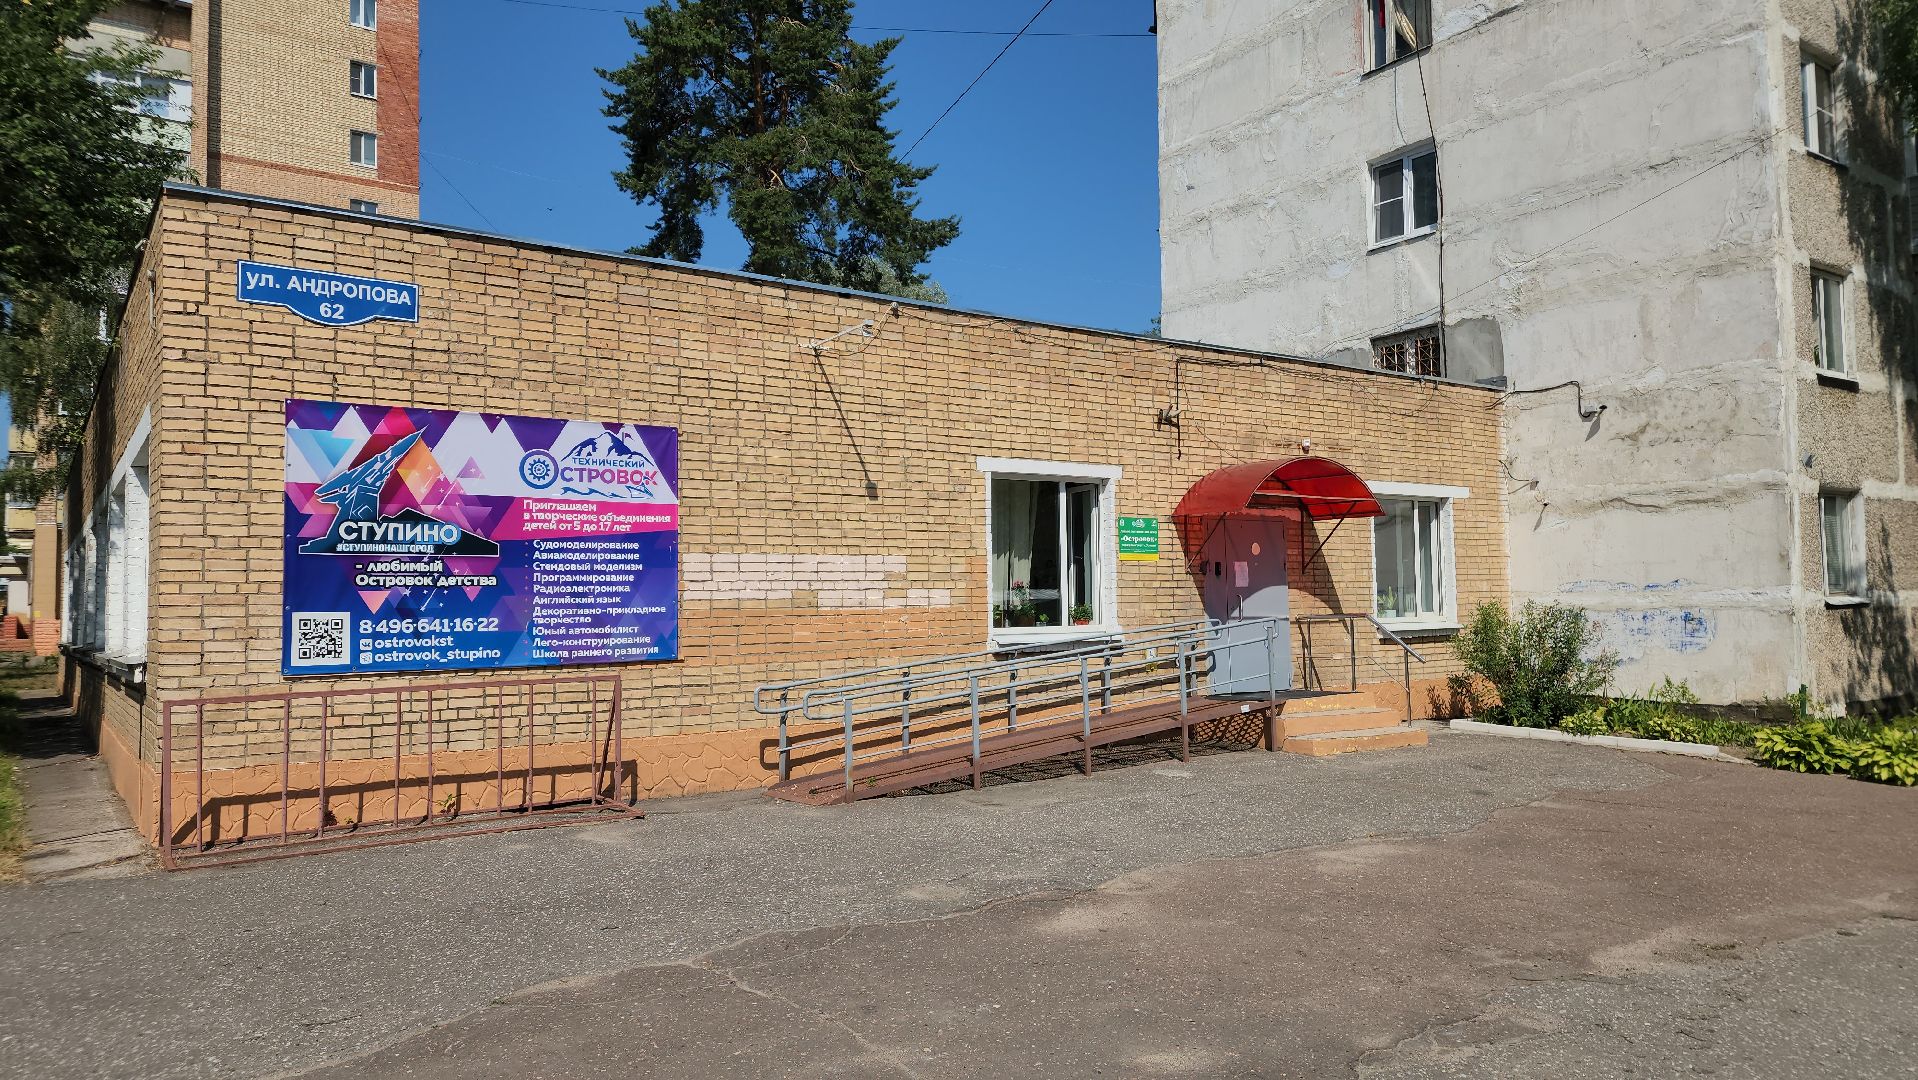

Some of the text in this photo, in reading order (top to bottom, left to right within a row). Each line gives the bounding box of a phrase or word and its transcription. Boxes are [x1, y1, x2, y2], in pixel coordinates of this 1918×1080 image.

[245, 271, 412, 306] ул. АНДРОПОВА
[319, 302, 345, 320] 62
[572, 457, 645, 468] ТЕХНИЧЕСКИЙ
[523, 500, 597, 512] Приглашаем
[532, 512, 597, 522] творческие
[599, 512, 671, 524] объединения
[338, 521, 458, 543] СТУПИНО
[523, 520, 632, 533] детей от 5 до 17 лет
[336, 543, 435, 554] #СТУПИНОНАШГОРОД
[533, 539, 640, 552] Судомоделирование
[533, 550, 640, 562] Авиамоделирование
[367, 560, 443, 572] любимый
[533, 562, 643, 572] Стендовый моделизм
[356, 575, 497, 588] Островок детства
[533, 573, 635, 584] Программирование
[533, 584, 631, 595] Радиоэлектроника
[533, 595, 622, 605] Английский язык
[533, 606, 667, 616] Декоративно-прикладное
[533, 625, 639, 636] Юный автомобилист
[374, 635, 455, 649] ostrovokst
[533, 636, 651, 648] Лего-конструирование
[374, 647, 501, 663] ostrovok_stupino
[533, 647, 659, 658] Школа раннего развития
